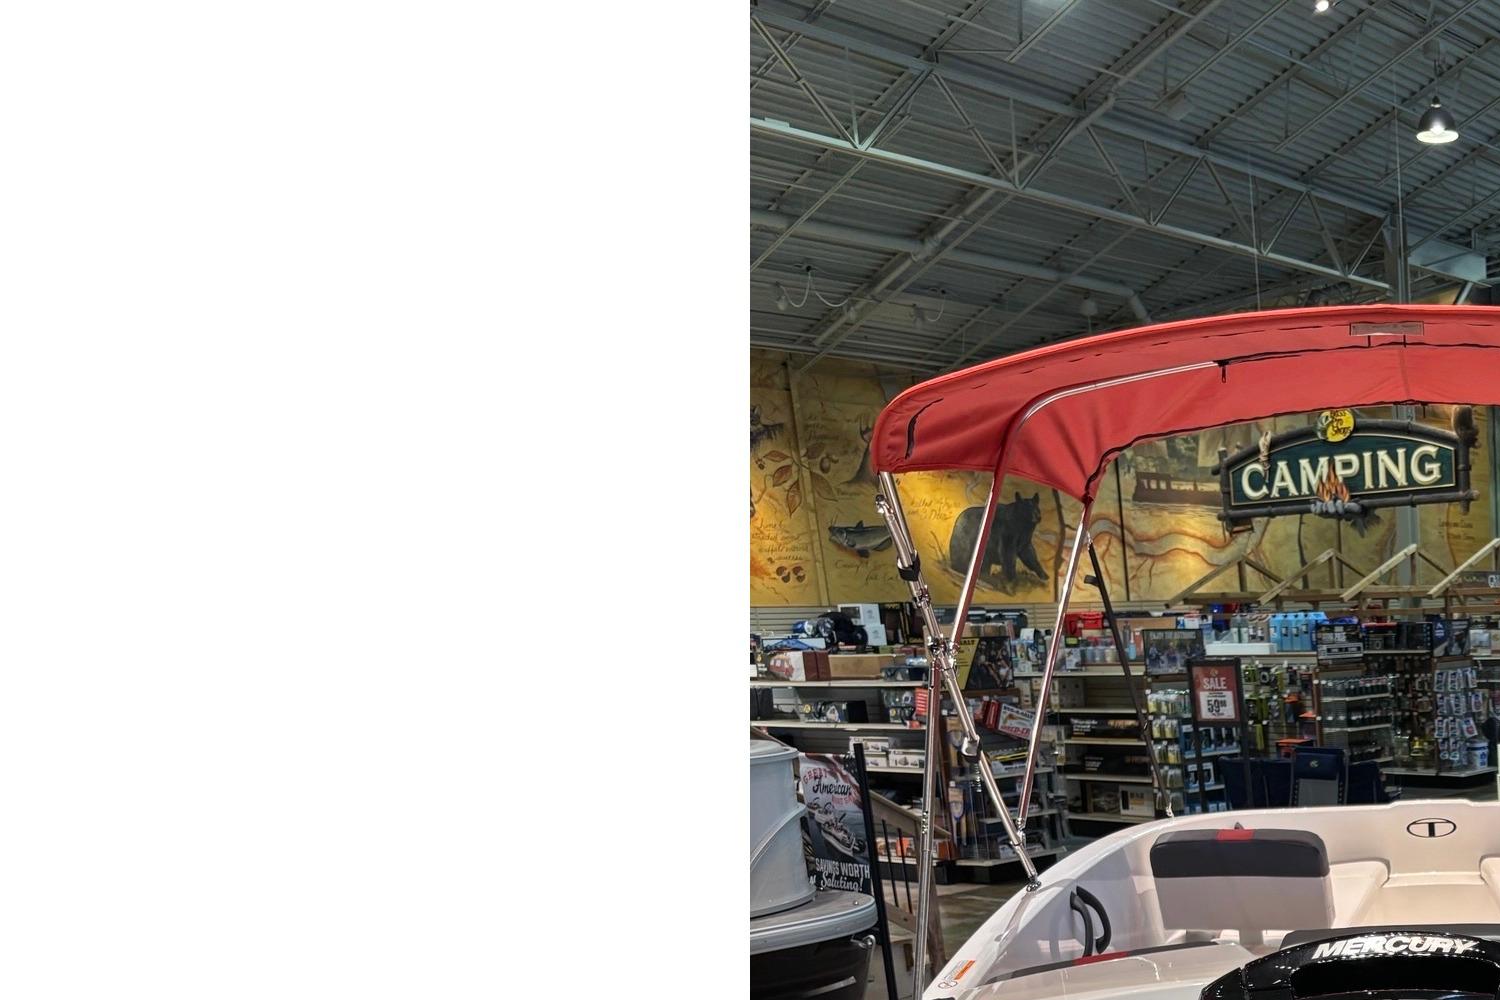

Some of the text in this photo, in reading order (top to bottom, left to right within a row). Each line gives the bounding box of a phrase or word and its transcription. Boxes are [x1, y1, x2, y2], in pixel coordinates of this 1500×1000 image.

[1241, 445, 1442, 499] CAMPING
[1203, 677, 1228, 689] SALE
[812, 775, 853, 797] American
[815, 858, 840, 876] SAVINGS
[840, 862, 871, 879] WORTH
[820, 870, 864, 891] Saluting!
[1311, 936, 1481, 961] MERCURY
